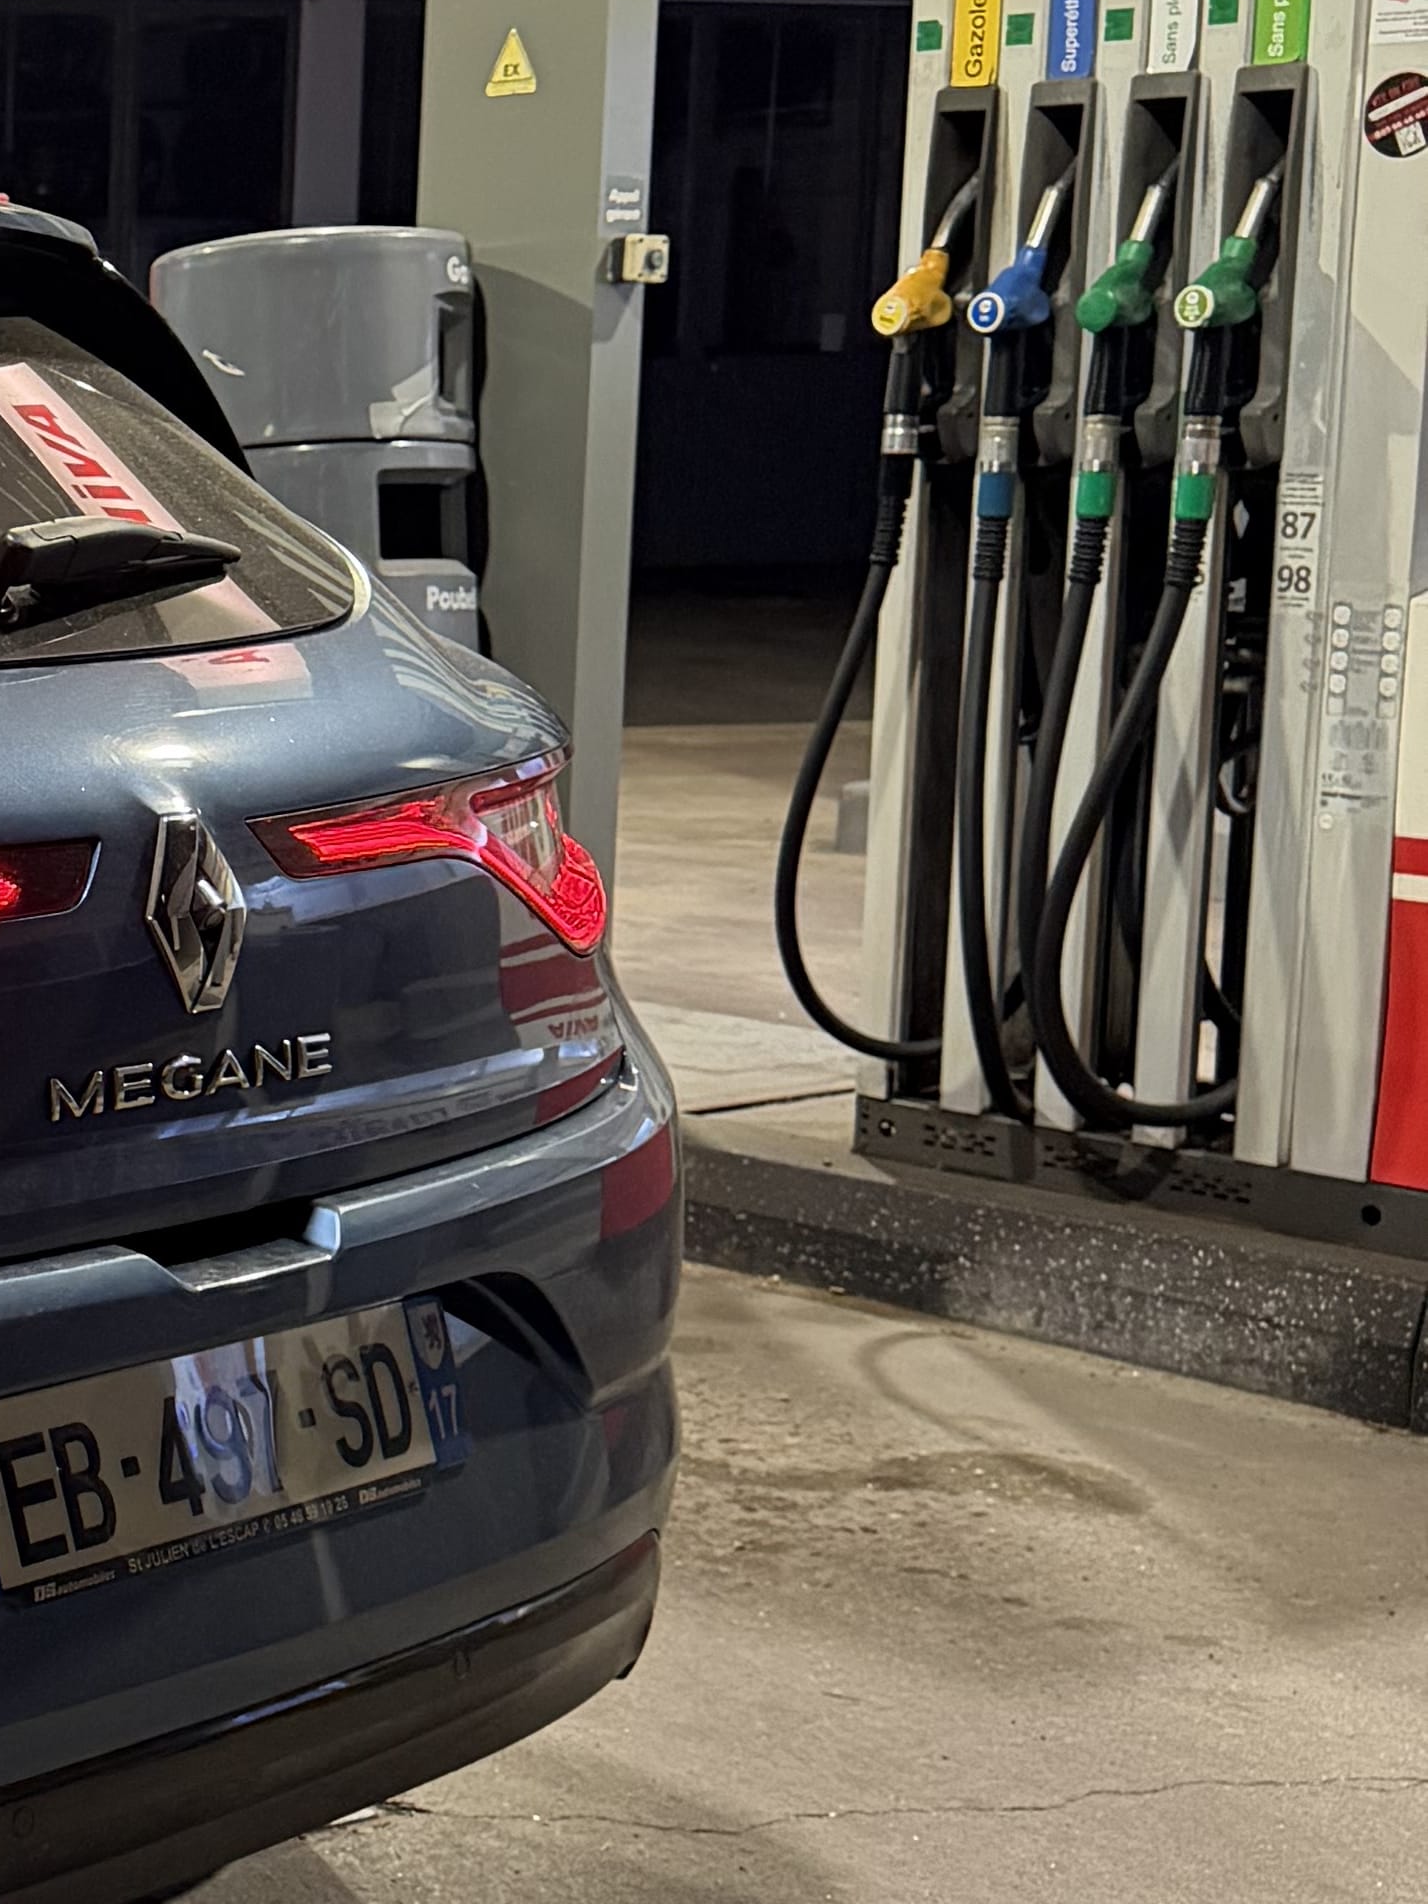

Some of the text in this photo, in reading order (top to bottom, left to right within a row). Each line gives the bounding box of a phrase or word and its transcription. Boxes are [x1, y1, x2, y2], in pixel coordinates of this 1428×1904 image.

[1162, 21, 1179, 64] Sans
[1267, 11, 1286, 57] Sans
[503, 63, 521, 78] EX
[1280, 511, 1317, 540] 87
[1276, 565, 1312, 594] 98
[49, 1031, 333, 1122] MEGANE
[428, 1383, 460, 1441] 17
[145, 1542, 191, 1569] JULIEN
